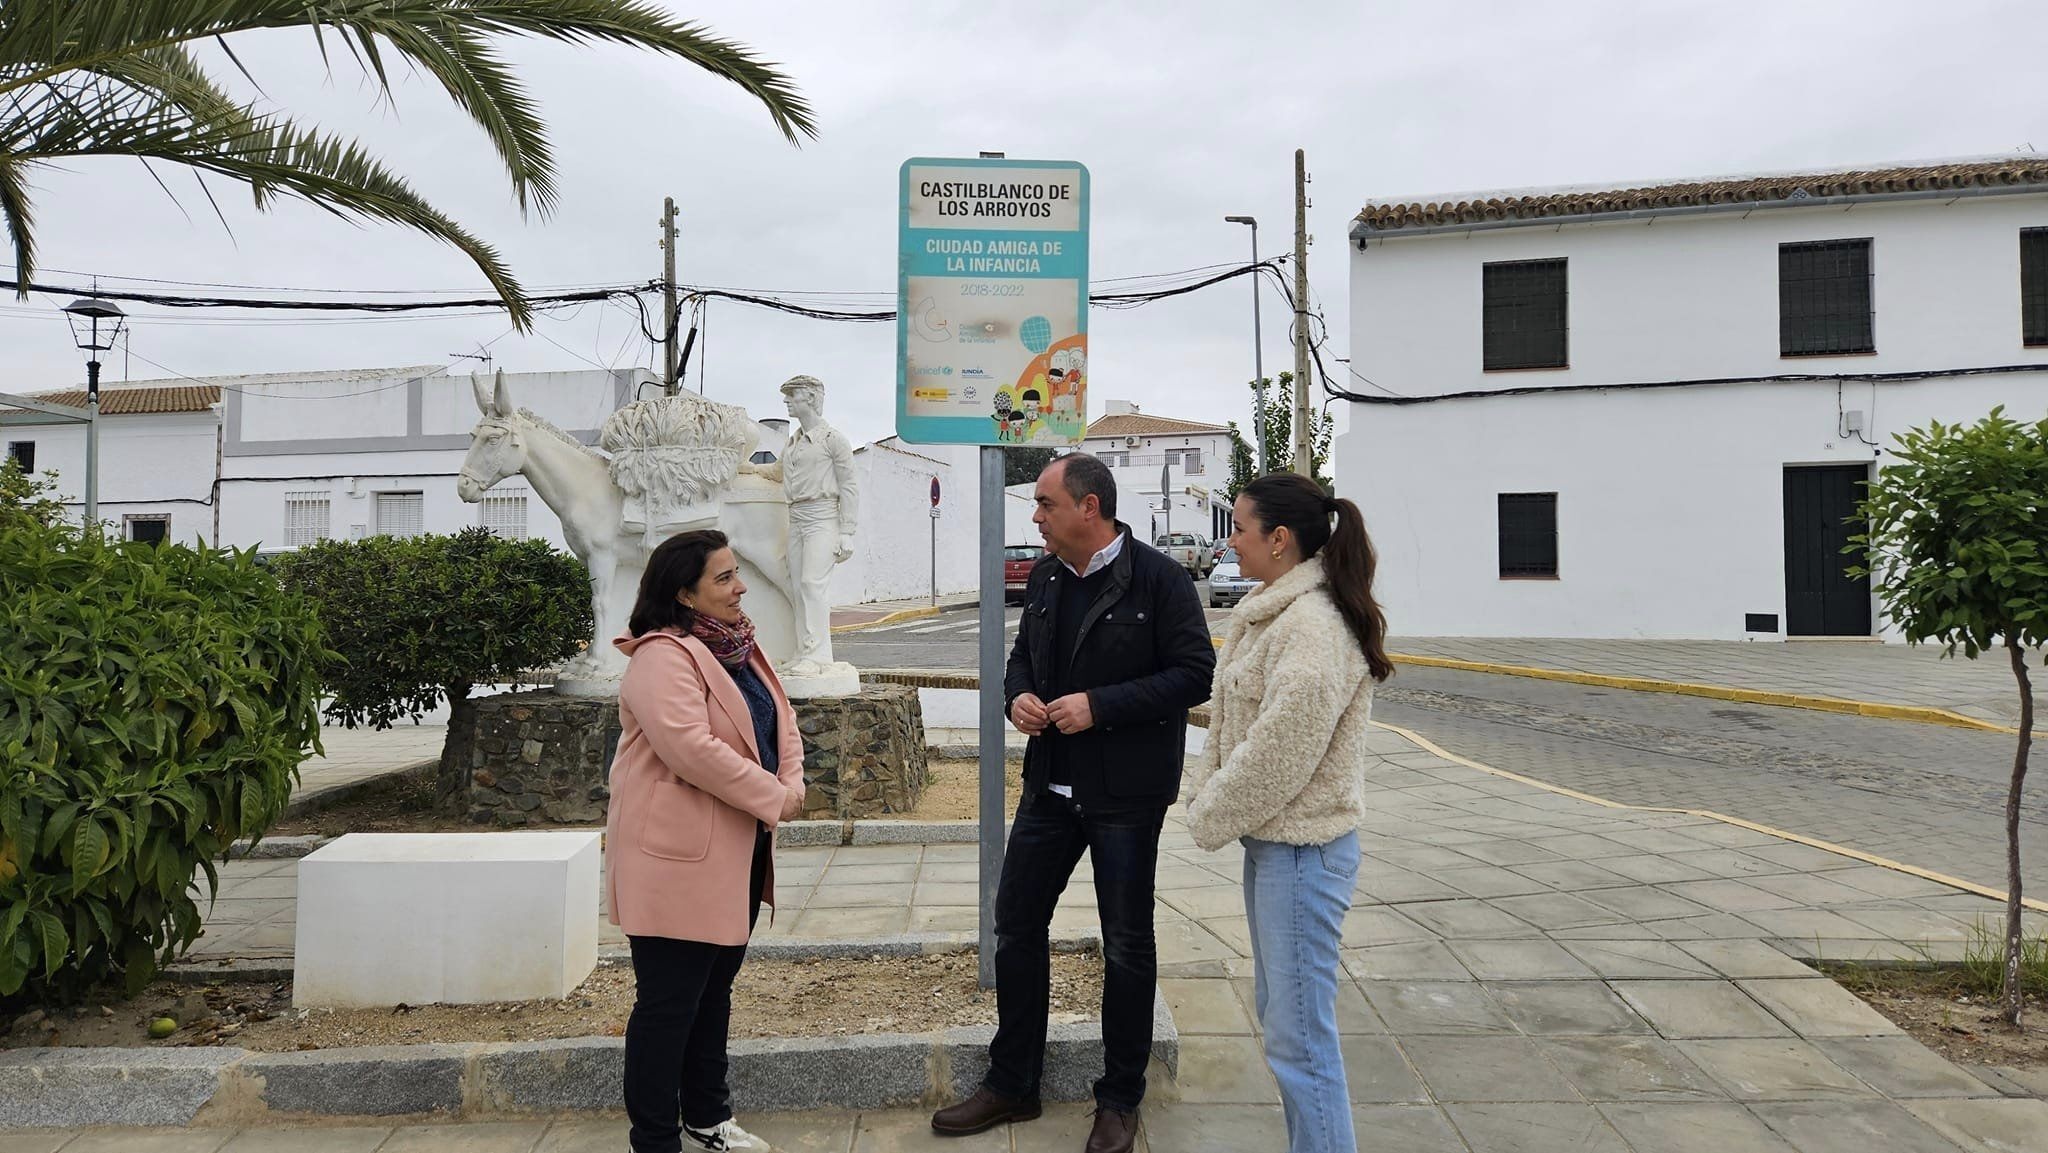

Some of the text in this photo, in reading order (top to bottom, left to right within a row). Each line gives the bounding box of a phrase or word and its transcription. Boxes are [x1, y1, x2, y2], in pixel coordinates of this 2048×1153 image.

[920, 181, 1070, 200] CASTILBLANCO DE
[938, 200, 1051, 217] LOS ARROYOS
[926, 239, 1062, 256] CIUDAD AMIGA DE
[947, 257, 1041, 273] LA INFANCIA
[960, 284, 1025, 296] 2018-2022
